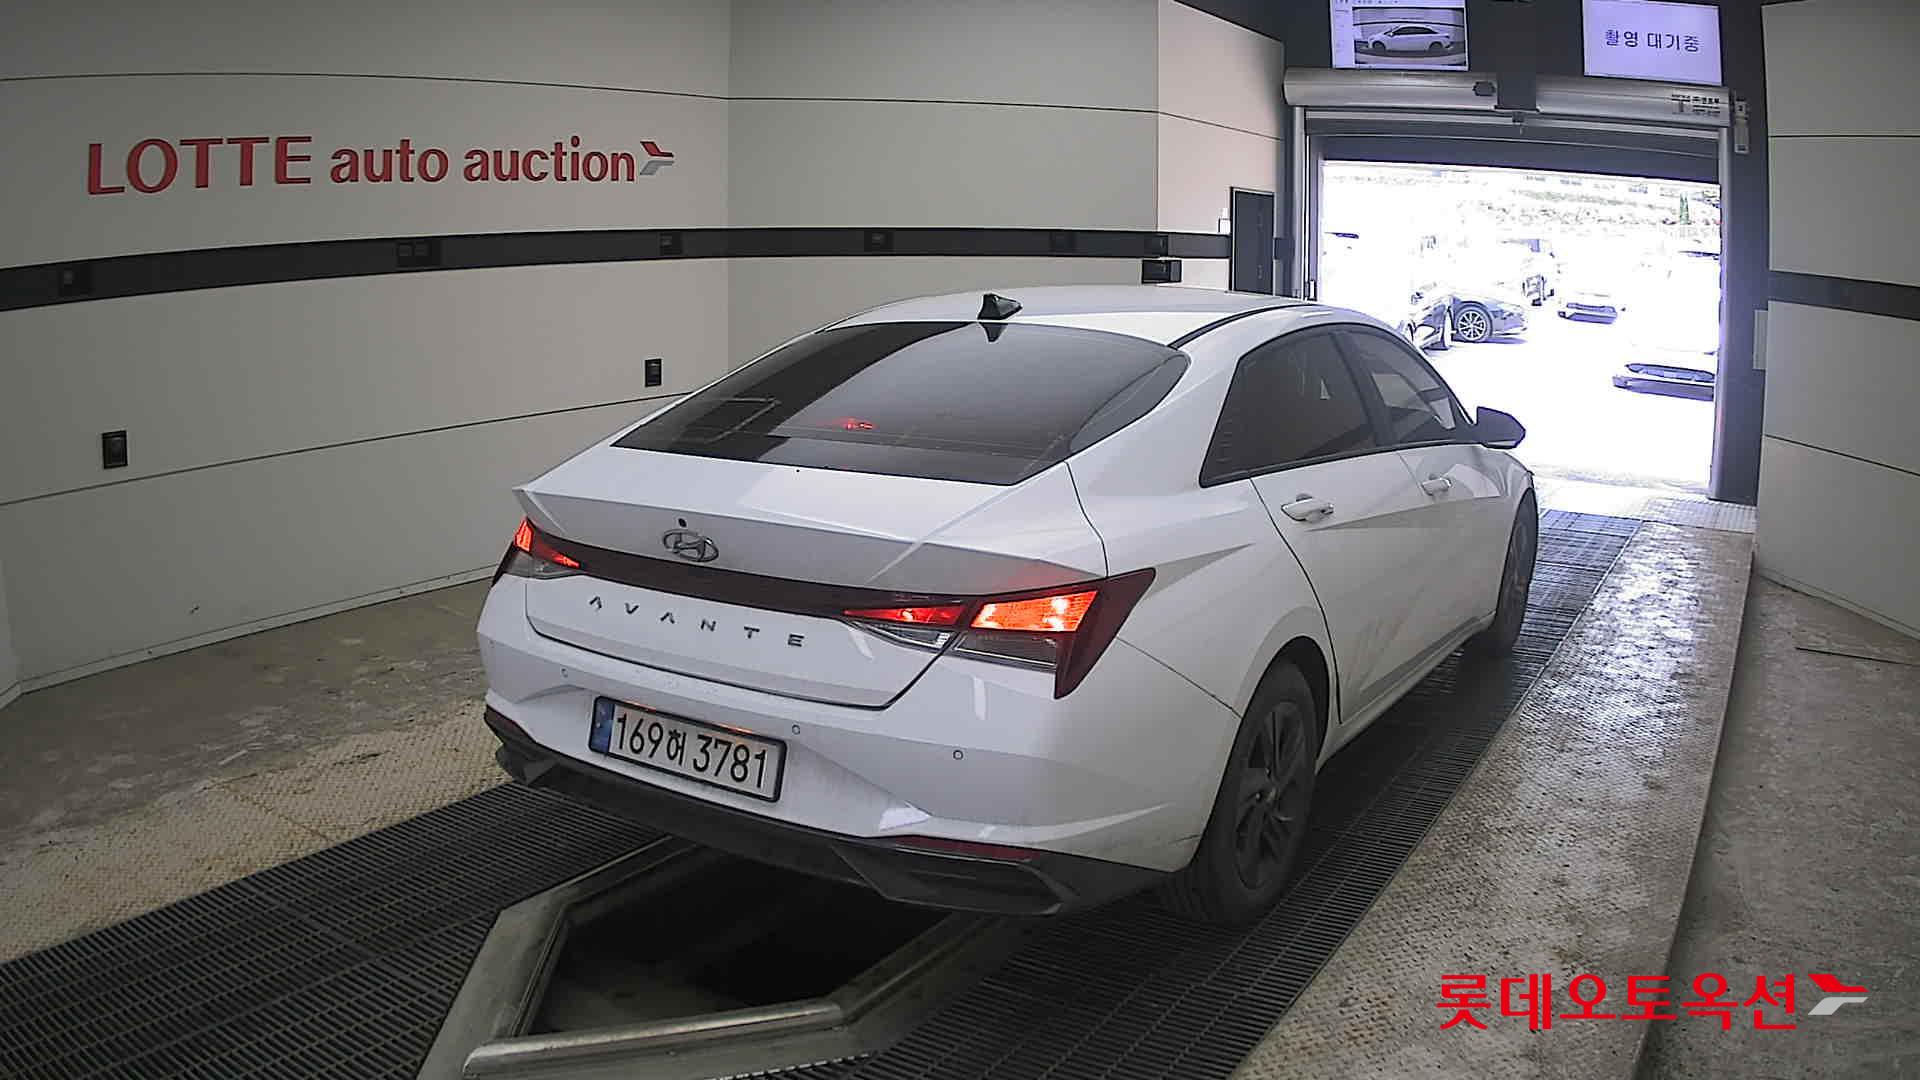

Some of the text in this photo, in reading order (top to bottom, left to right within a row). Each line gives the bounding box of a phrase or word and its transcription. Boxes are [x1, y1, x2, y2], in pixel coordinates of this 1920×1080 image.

[1606, 29, 1699, 52] 촬영 대기중
[87, 136, 636, 195] LOTTE auto auction
[588, 596, 804, 647] AVANTE
